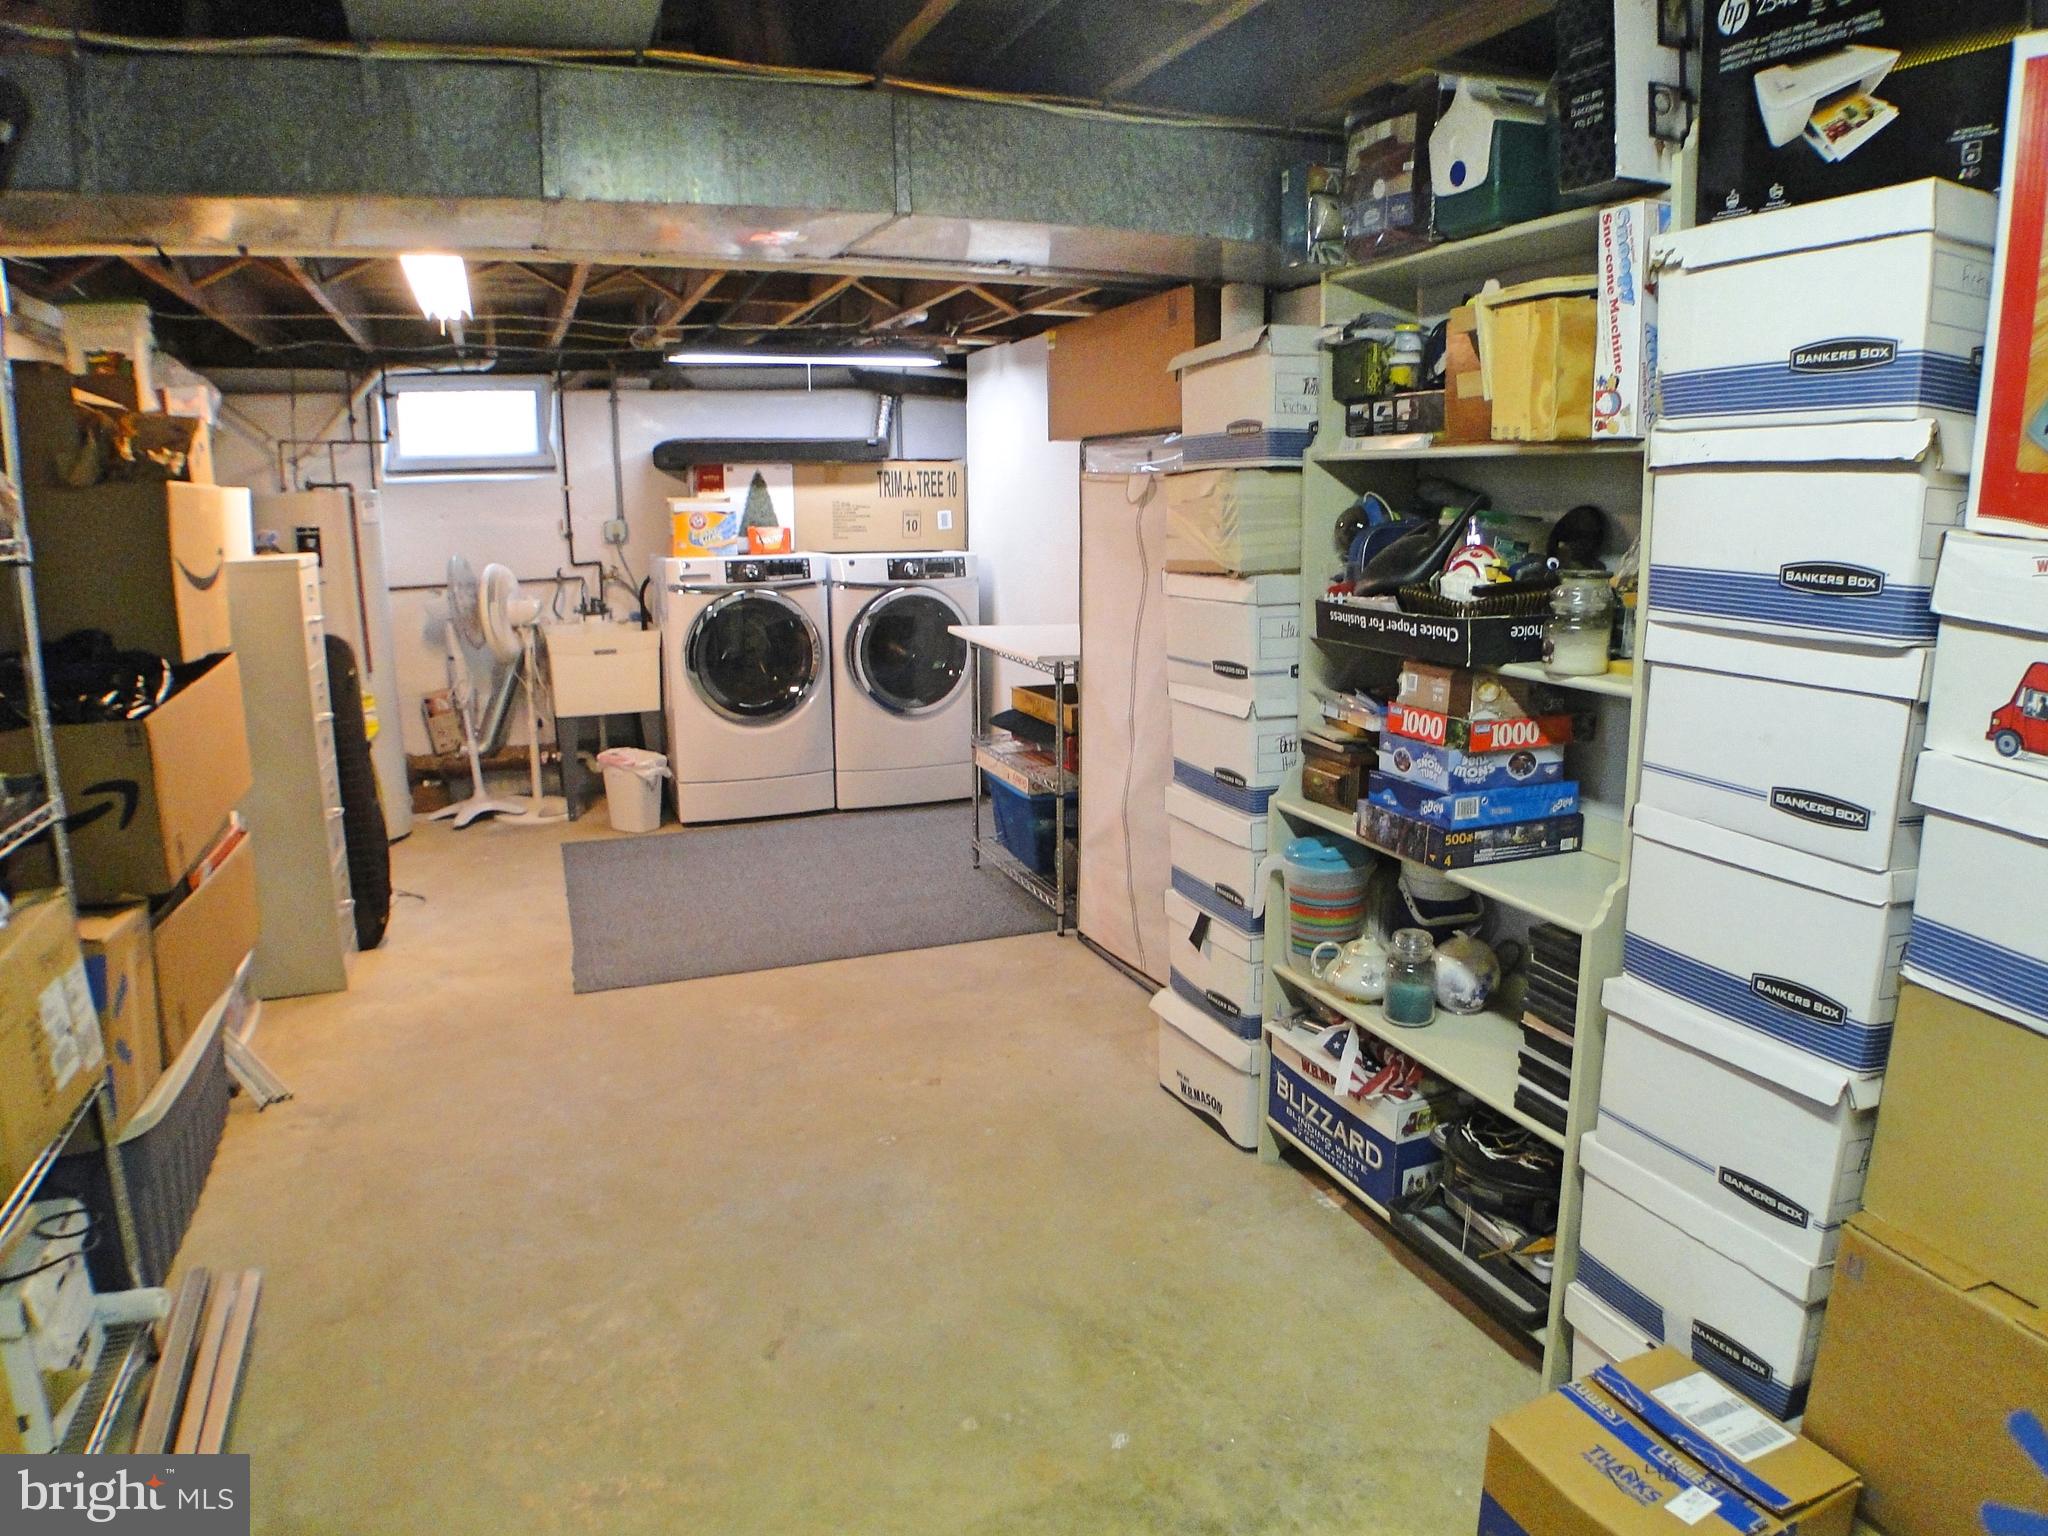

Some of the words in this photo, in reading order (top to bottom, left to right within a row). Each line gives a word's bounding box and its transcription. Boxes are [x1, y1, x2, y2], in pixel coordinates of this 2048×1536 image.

[1617, 207, 1635, 306] Snoopy
[1602, 213, 1615, 295] Sno-cone
[1609, 297, 1623, 375] Machine
[1796, 349, 1856, 365] BANKERS
[1860, 347, 1890, 358] BOX
[947, 471, 958, 497] 10
[906, 519, 918, 532] 10
[1785, 571, 1844, 585] BANKERS
[1848, 576, 1876, 588] BOX
[1329, 610, 1367, 629] Business
[1369, 615, 1385, 632] For
[1387, 618, 1417, 637] Paper
[1421, 623, 1460, 642] Choice
[1510, 624, 1544, 640] hoice
[1401, 709, 1443, 740] 1000
[1490, 721, 1540, 748] 1000
[1775, 793, 1834, 816] BANKERS
[1835, 808, 1864, 824] BOX
[1444, 855, 1453, 867] 4
[1757, 980, 1811, 1008] BANKERS
[1813, 1001, 1839, 1019] BOX
[1276, 1070, 1383, 1169] BLIZZARD
[1286, 1106, 1332, 1147] BLINDING
[1335, 1144, 1369, 1176] WHITE
[1723, 1173, 1777, 1207] BANKERS
[1777, 1201, 1803, 1221] BOX
[1692, 1324, 1740, 1361] BANKERS
[1742, 1355, 1766, 1376] BOX
[1589, 1444, 1663, 1503] THANKS
